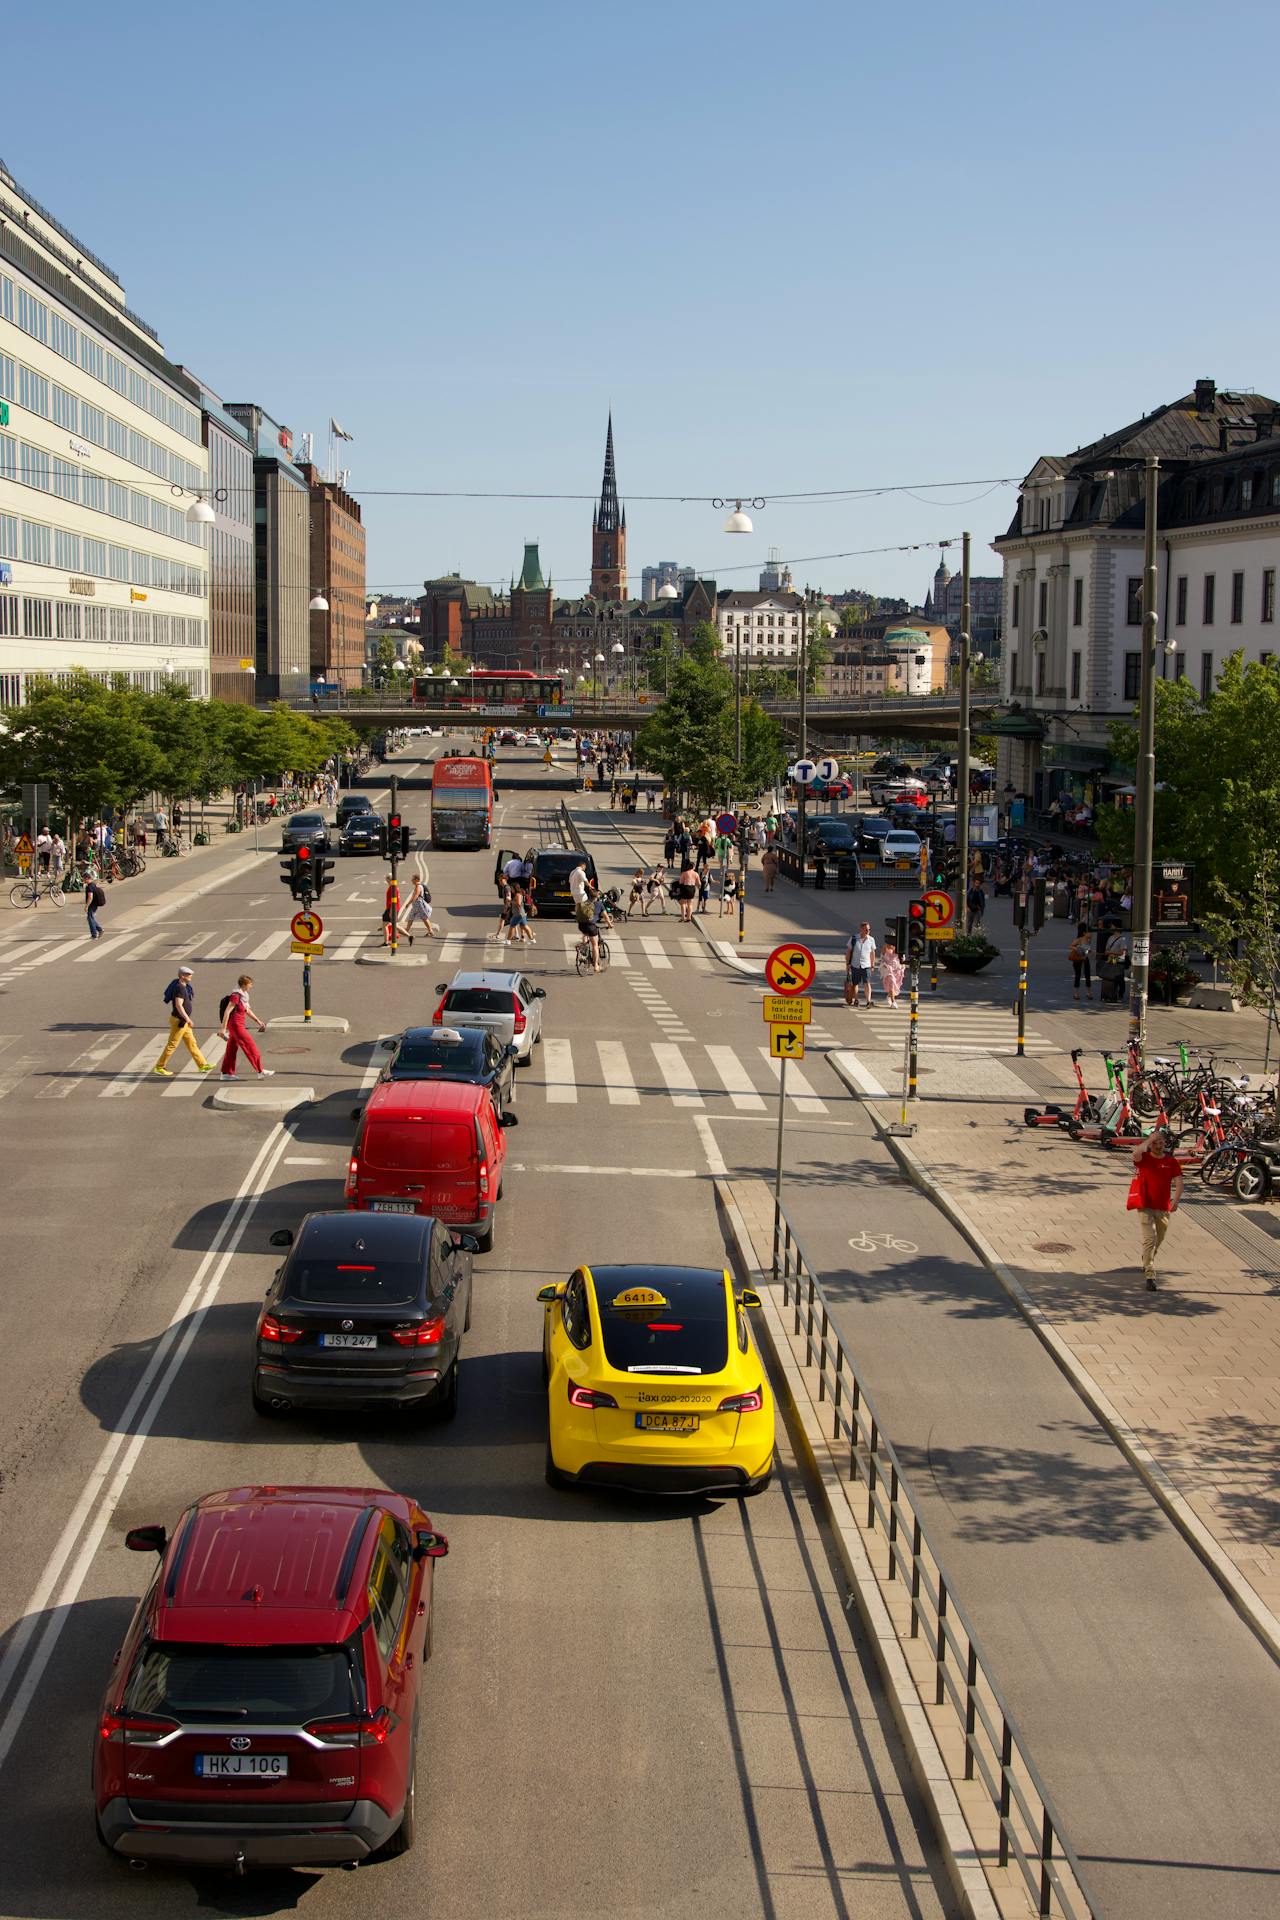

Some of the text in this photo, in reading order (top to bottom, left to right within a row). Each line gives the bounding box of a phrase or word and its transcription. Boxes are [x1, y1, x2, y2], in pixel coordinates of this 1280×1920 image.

[798, 765, 812, 780] T
[821, 762, 832, 779] J
[624, 1293, 654, 1302] 6413
[328, 1335, 373, 1346] JSY 247
[646, 1415, 695, 1428] DCA 87J
[209, 1757, 242, 1773] HKJ
